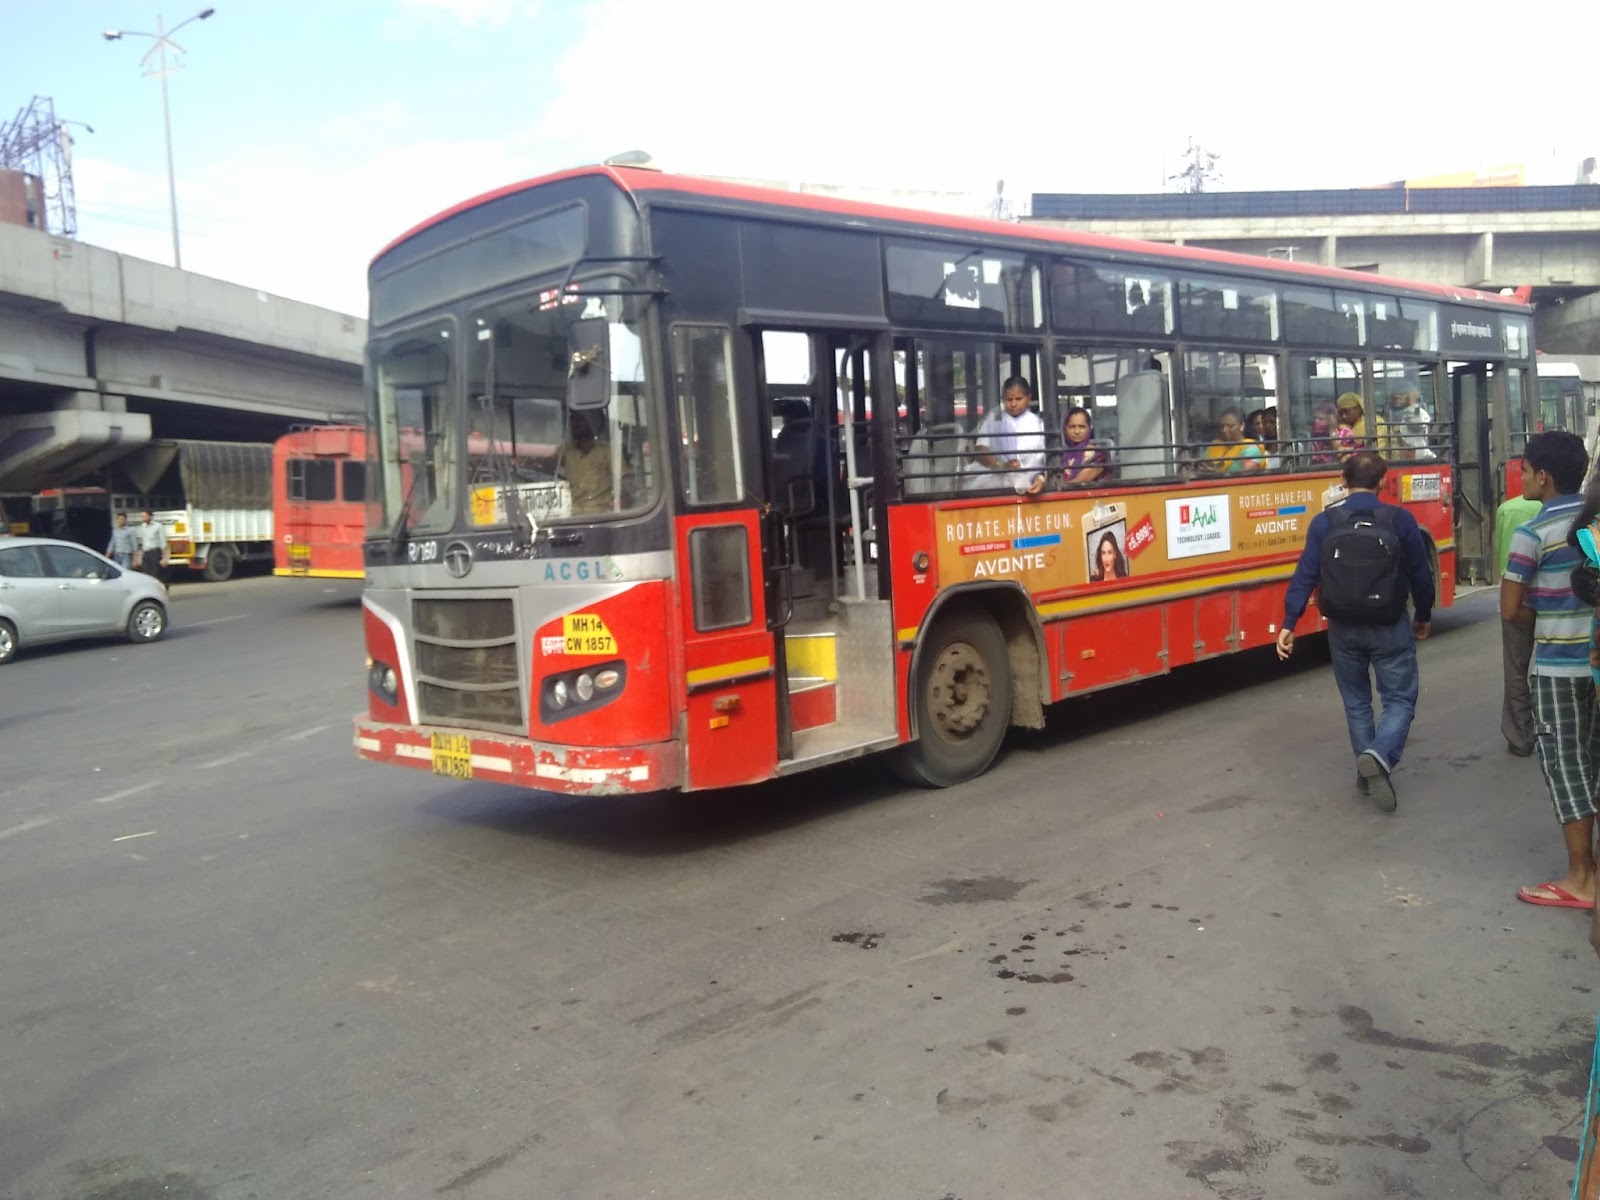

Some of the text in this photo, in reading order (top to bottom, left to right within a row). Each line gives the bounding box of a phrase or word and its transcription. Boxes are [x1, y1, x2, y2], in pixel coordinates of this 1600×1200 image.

[1239, 494, 1273, 508] ROTATE.
[1274, 491, 1295, 504] HAVE
[947, 513, 1073, 541] ROTATE. HAVE FUN.
[1255, 519, 1297, 535] AVONTE
[974, 553, 1045, 577] AVONTE
[572, 618, 603, 632] MH 14
[566, 637, 582, 651] CW
[585, 637, 612, 651] 1857
